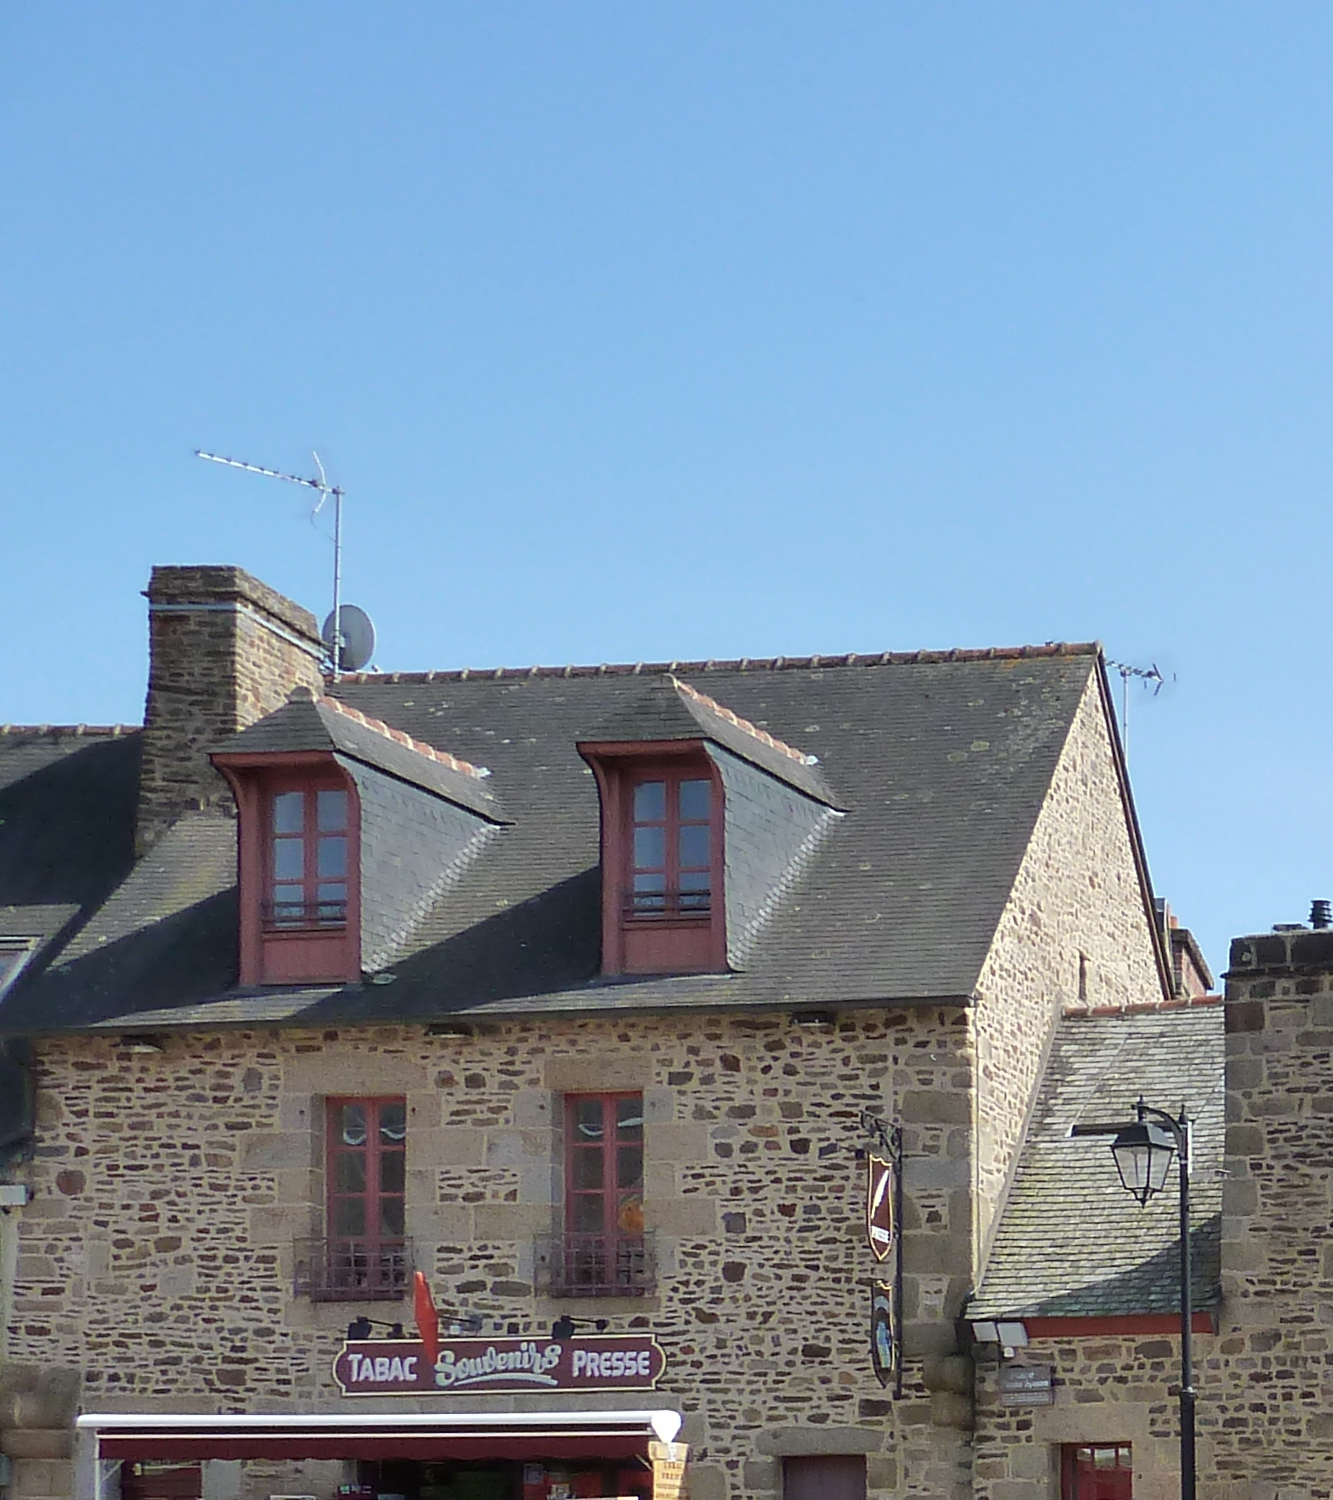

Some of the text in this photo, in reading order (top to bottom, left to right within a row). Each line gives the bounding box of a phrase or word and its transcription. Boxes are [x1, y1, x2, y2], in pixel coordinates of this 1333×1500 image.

[347, 1342, 650, 1387] TABAC Souvenirs PRESSE
